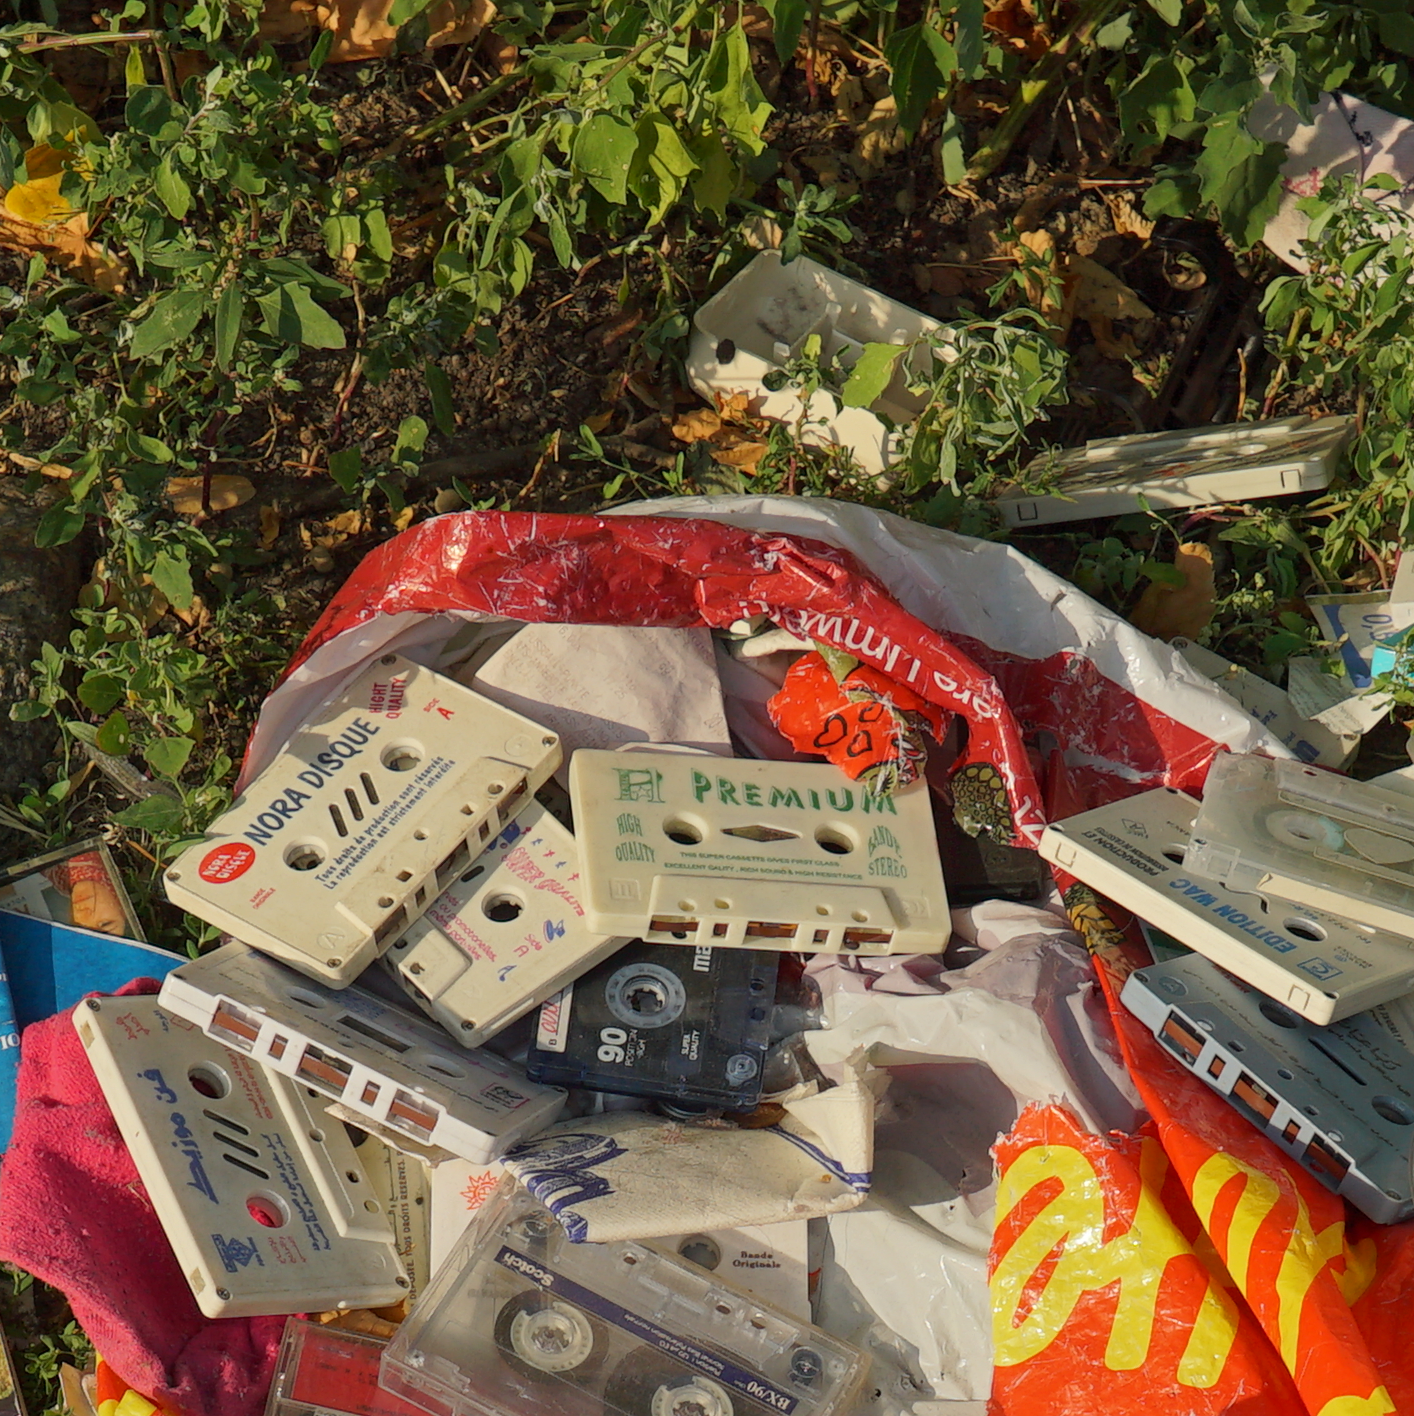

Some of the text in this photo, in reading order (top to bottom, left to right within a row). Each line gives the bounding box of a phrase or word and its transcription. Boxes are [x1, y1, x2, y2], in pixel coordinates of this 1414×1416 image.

[369, 682, 385, 714] HIGHT
[387, 678, 404, 718] QUALITY
[240, 715, 383, 847] NORA DISQUE
[690, 767, 898, 816] PREMIUM
[314, 863, 338, 884] Tous
[331, 842, 358, 866] droits
[352, 833, 367, 845] de
[361, 798, 402, 836] production
[396, 782, 416, 800] sont
[615, 812, 643, 837] HIGH
[613, 840, 656, 863] QUALITY
[866, 855, 908, 878] STEREO
[1165, 874, 1301, 955] EDITION WAC
[594, 1025, 629, 1064] 90
[680, 1033, 691, 1055] SUPER
[688, 1029, 701, 1060] QUALITY
[501, 1249, 555, 1288] Scotch
[732, 1259, 782, 1270] Originale
[740, 1250, 774, 1260] Bande
[745, 1377, 791, 1411] BX/90
